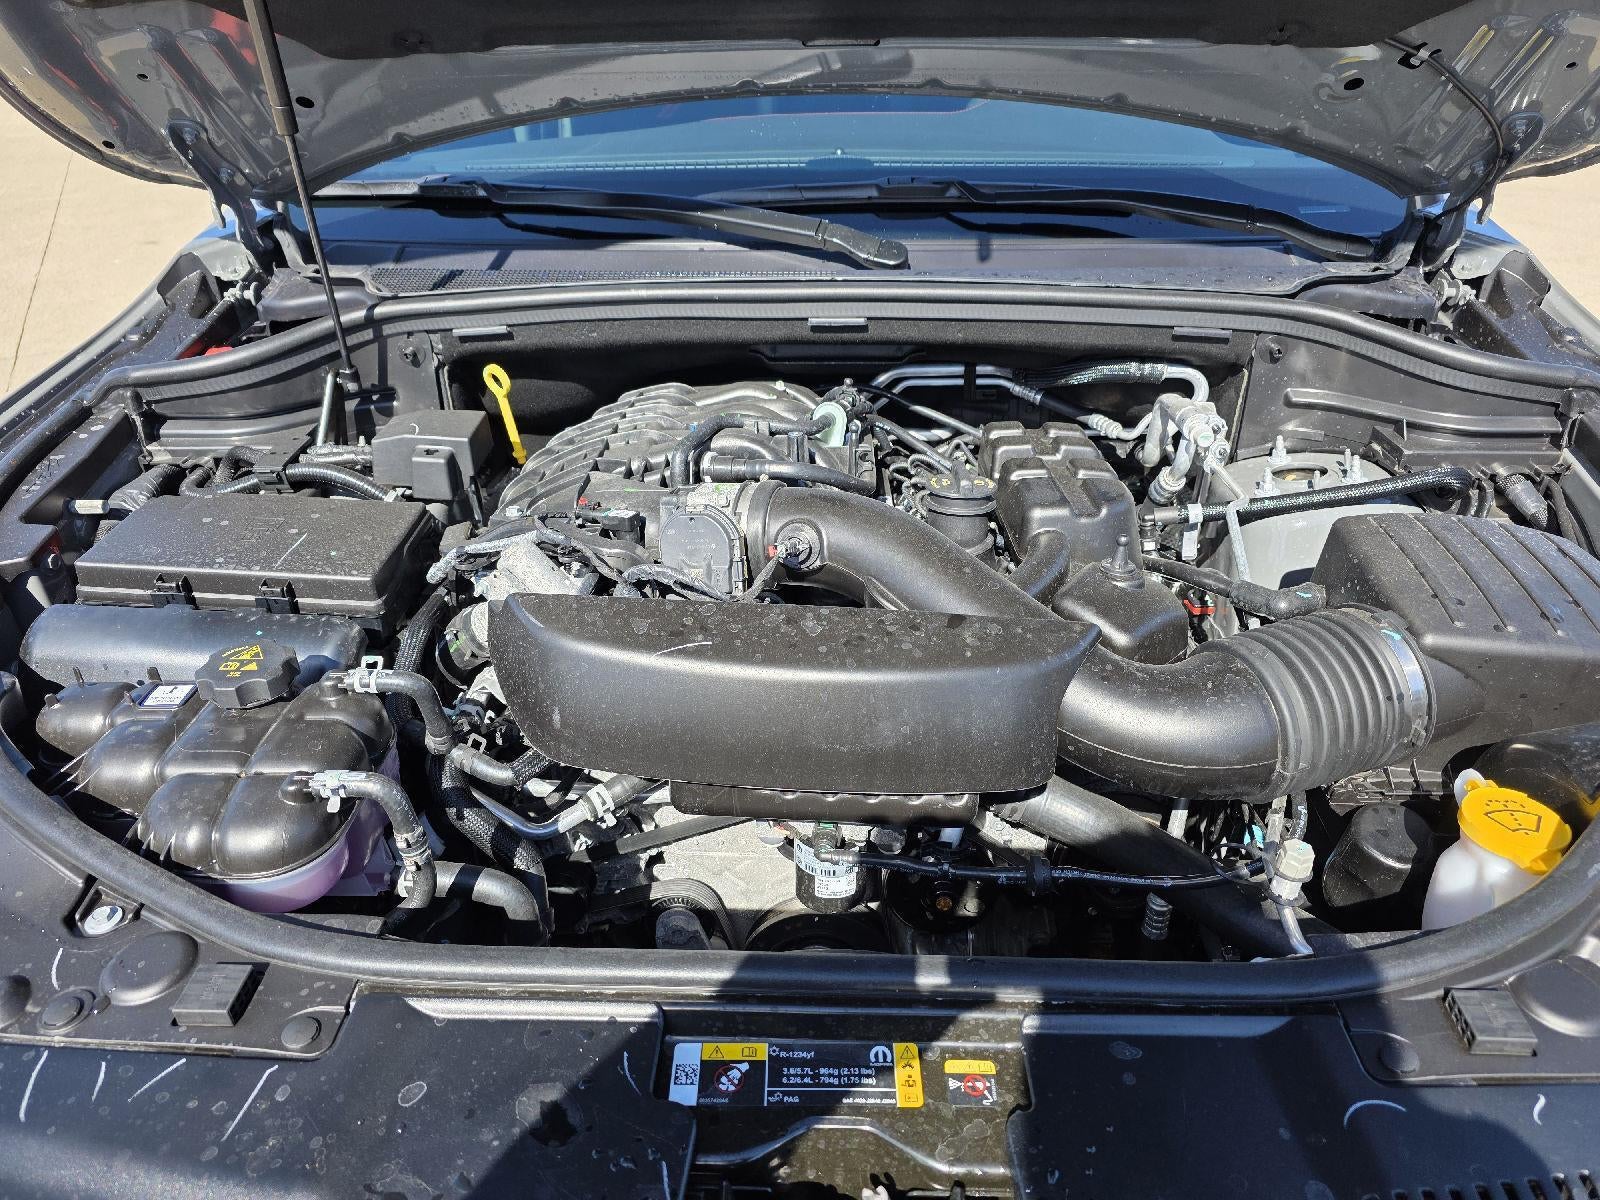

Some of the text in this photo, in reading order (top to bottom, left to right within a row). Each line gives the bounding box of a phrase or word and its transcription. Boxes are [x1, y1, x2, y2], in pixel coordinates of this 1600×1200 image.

[779, 1051, 815, 1059] R-1234yf
[840, 1067, 859, 1075] (2.13
[860, 1067, 875, 1075] lbs)
[860, 1077, 876, 1085] lbs)
[783, 1095, 800, 1103] PAG
